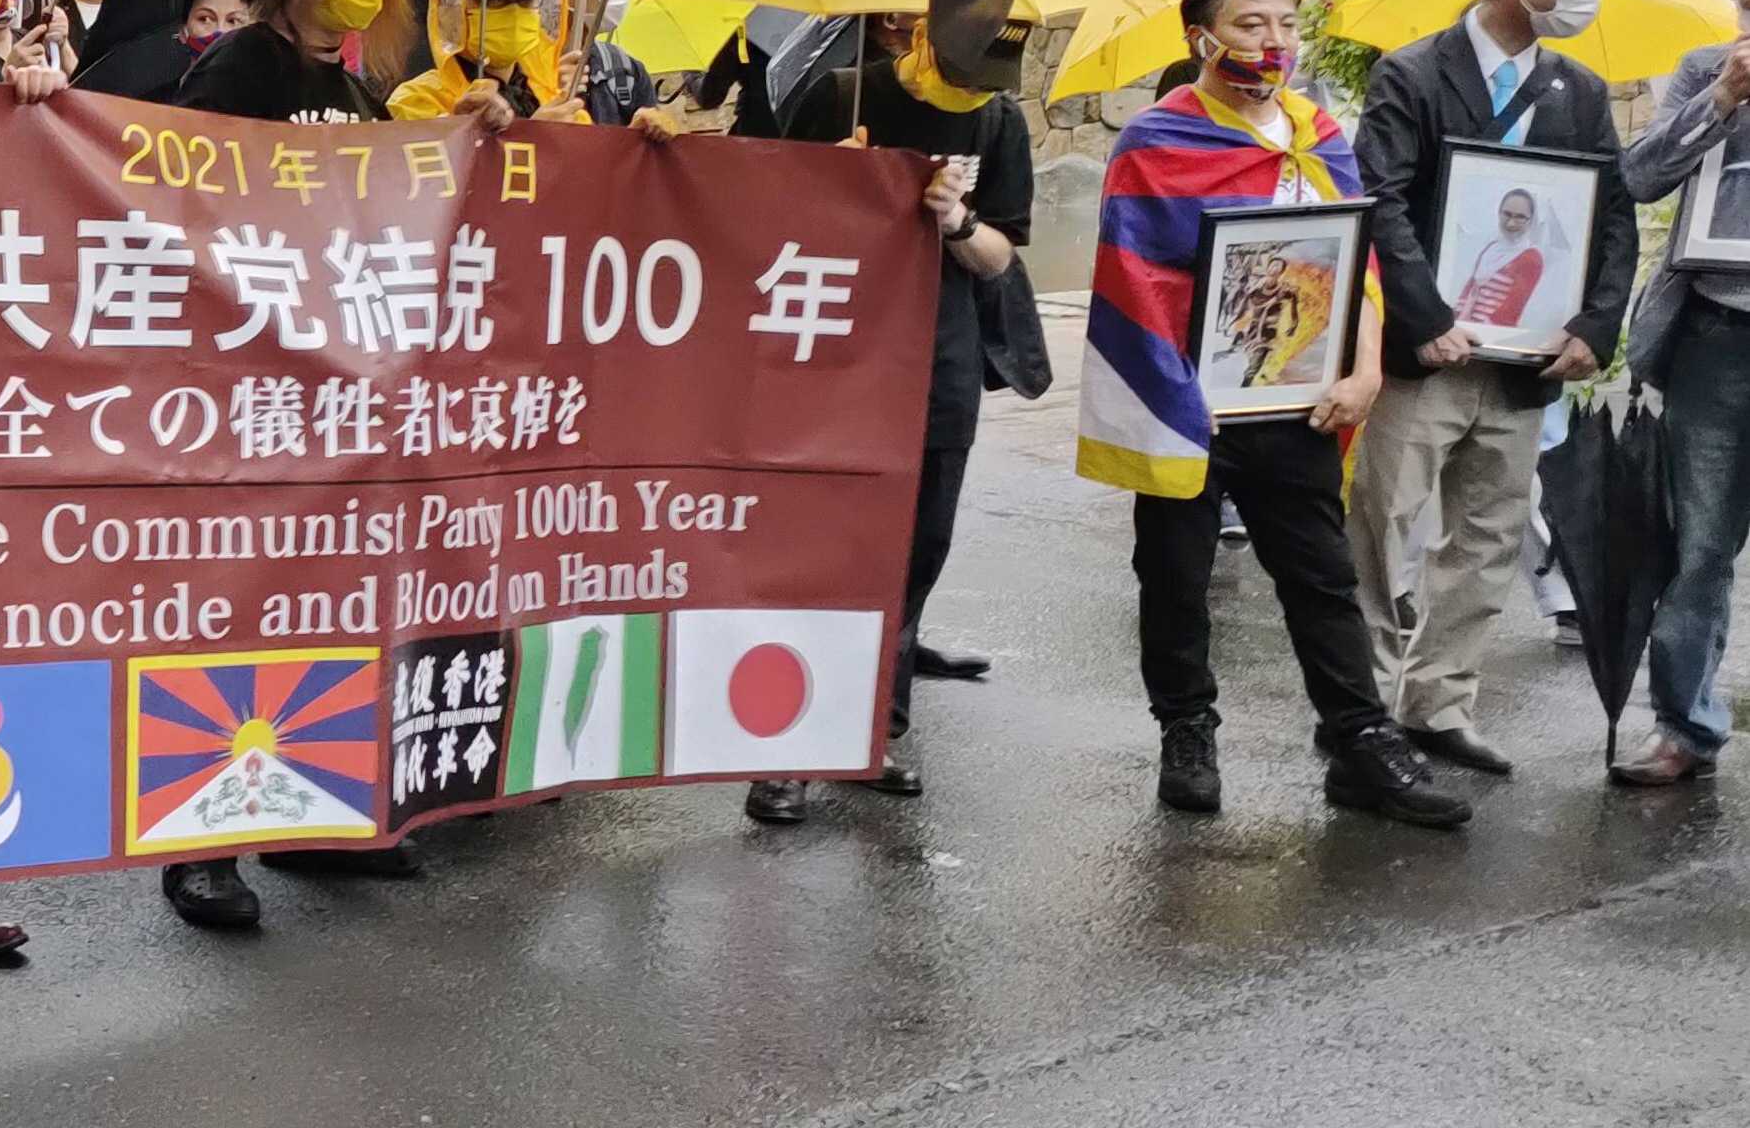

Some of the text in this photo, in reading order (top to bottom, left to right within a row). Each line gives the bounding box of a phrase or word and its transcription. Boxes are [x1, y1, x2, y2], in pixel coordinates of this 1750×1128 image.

[40, 500, 407, 565] Communist
[414, 494, 504, 558] Party
[514, 480, 619, 541] 100th
[633, 479, 759, 532] Year
[258, 576, 380, 639] and
[395, 563, 500, 631] Blood
[507, 570, 547, 615] on
[556, 547, 689, 607] Hands
